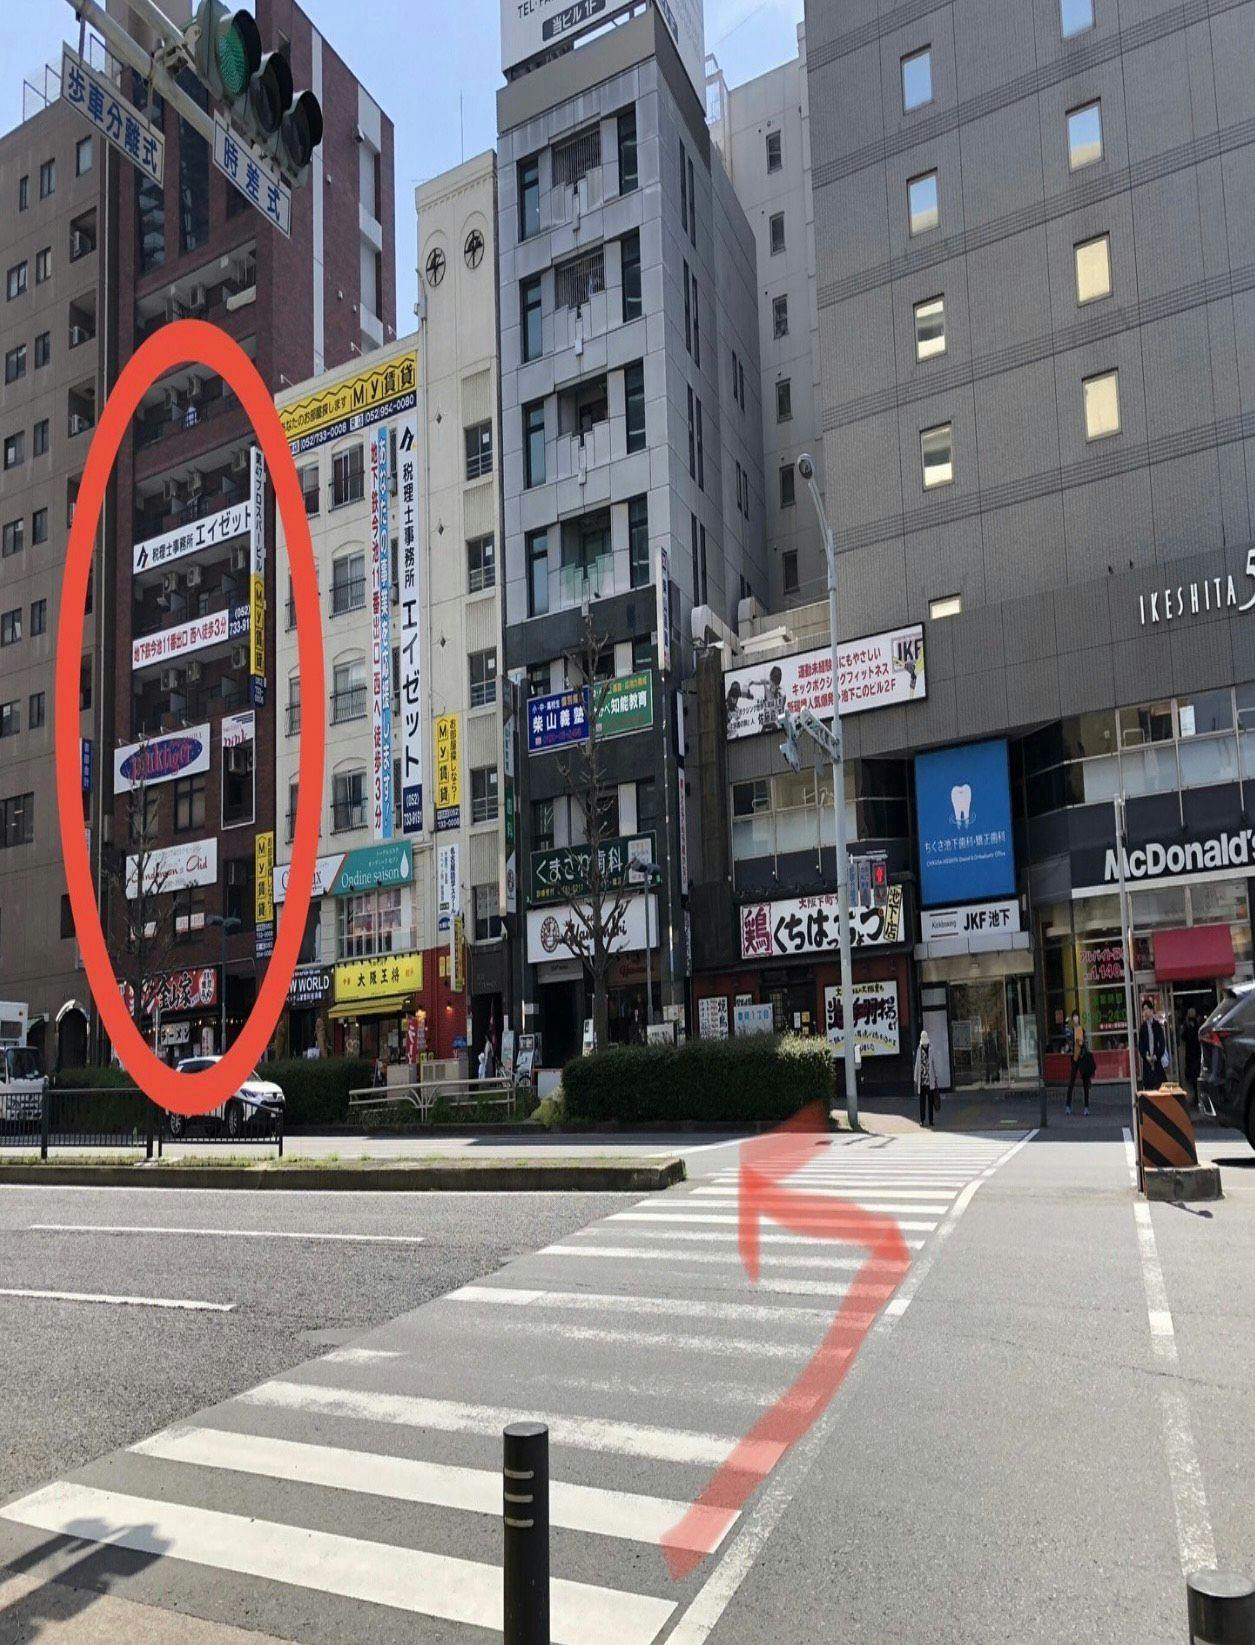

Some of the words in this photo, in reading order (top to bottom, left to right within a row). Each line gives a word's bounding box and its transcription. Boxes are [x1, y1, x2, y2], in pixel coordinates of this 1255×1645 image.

[67, 70, 159, 175] 歩車分離式
[223, 136, 281, 222] 時差式
[403, 461, 415, 588] 税理士事務所
[152, 533, 194, 562] 税理士事務所
[1140, 575, 1237, 625] IKESHITA
[798, 648, 881, 678] 運動未経験にもやさしい
[402, 599, 420, 778] エイゼット
[341, 869, 372, 888] Ondine
[373, 867, 400, 884] saison
[799, 894, 839, 909] 大阪下町
[744, 907, 772, 954] 鶏
[885, 888, 901, 939] 池下店
[964, 911, 987, 931] JKF
[989, 908, 1010, 928] 池下
[298, 975, 330, 993] WORLD
[357, 966, 400, 987] 大阪王将
